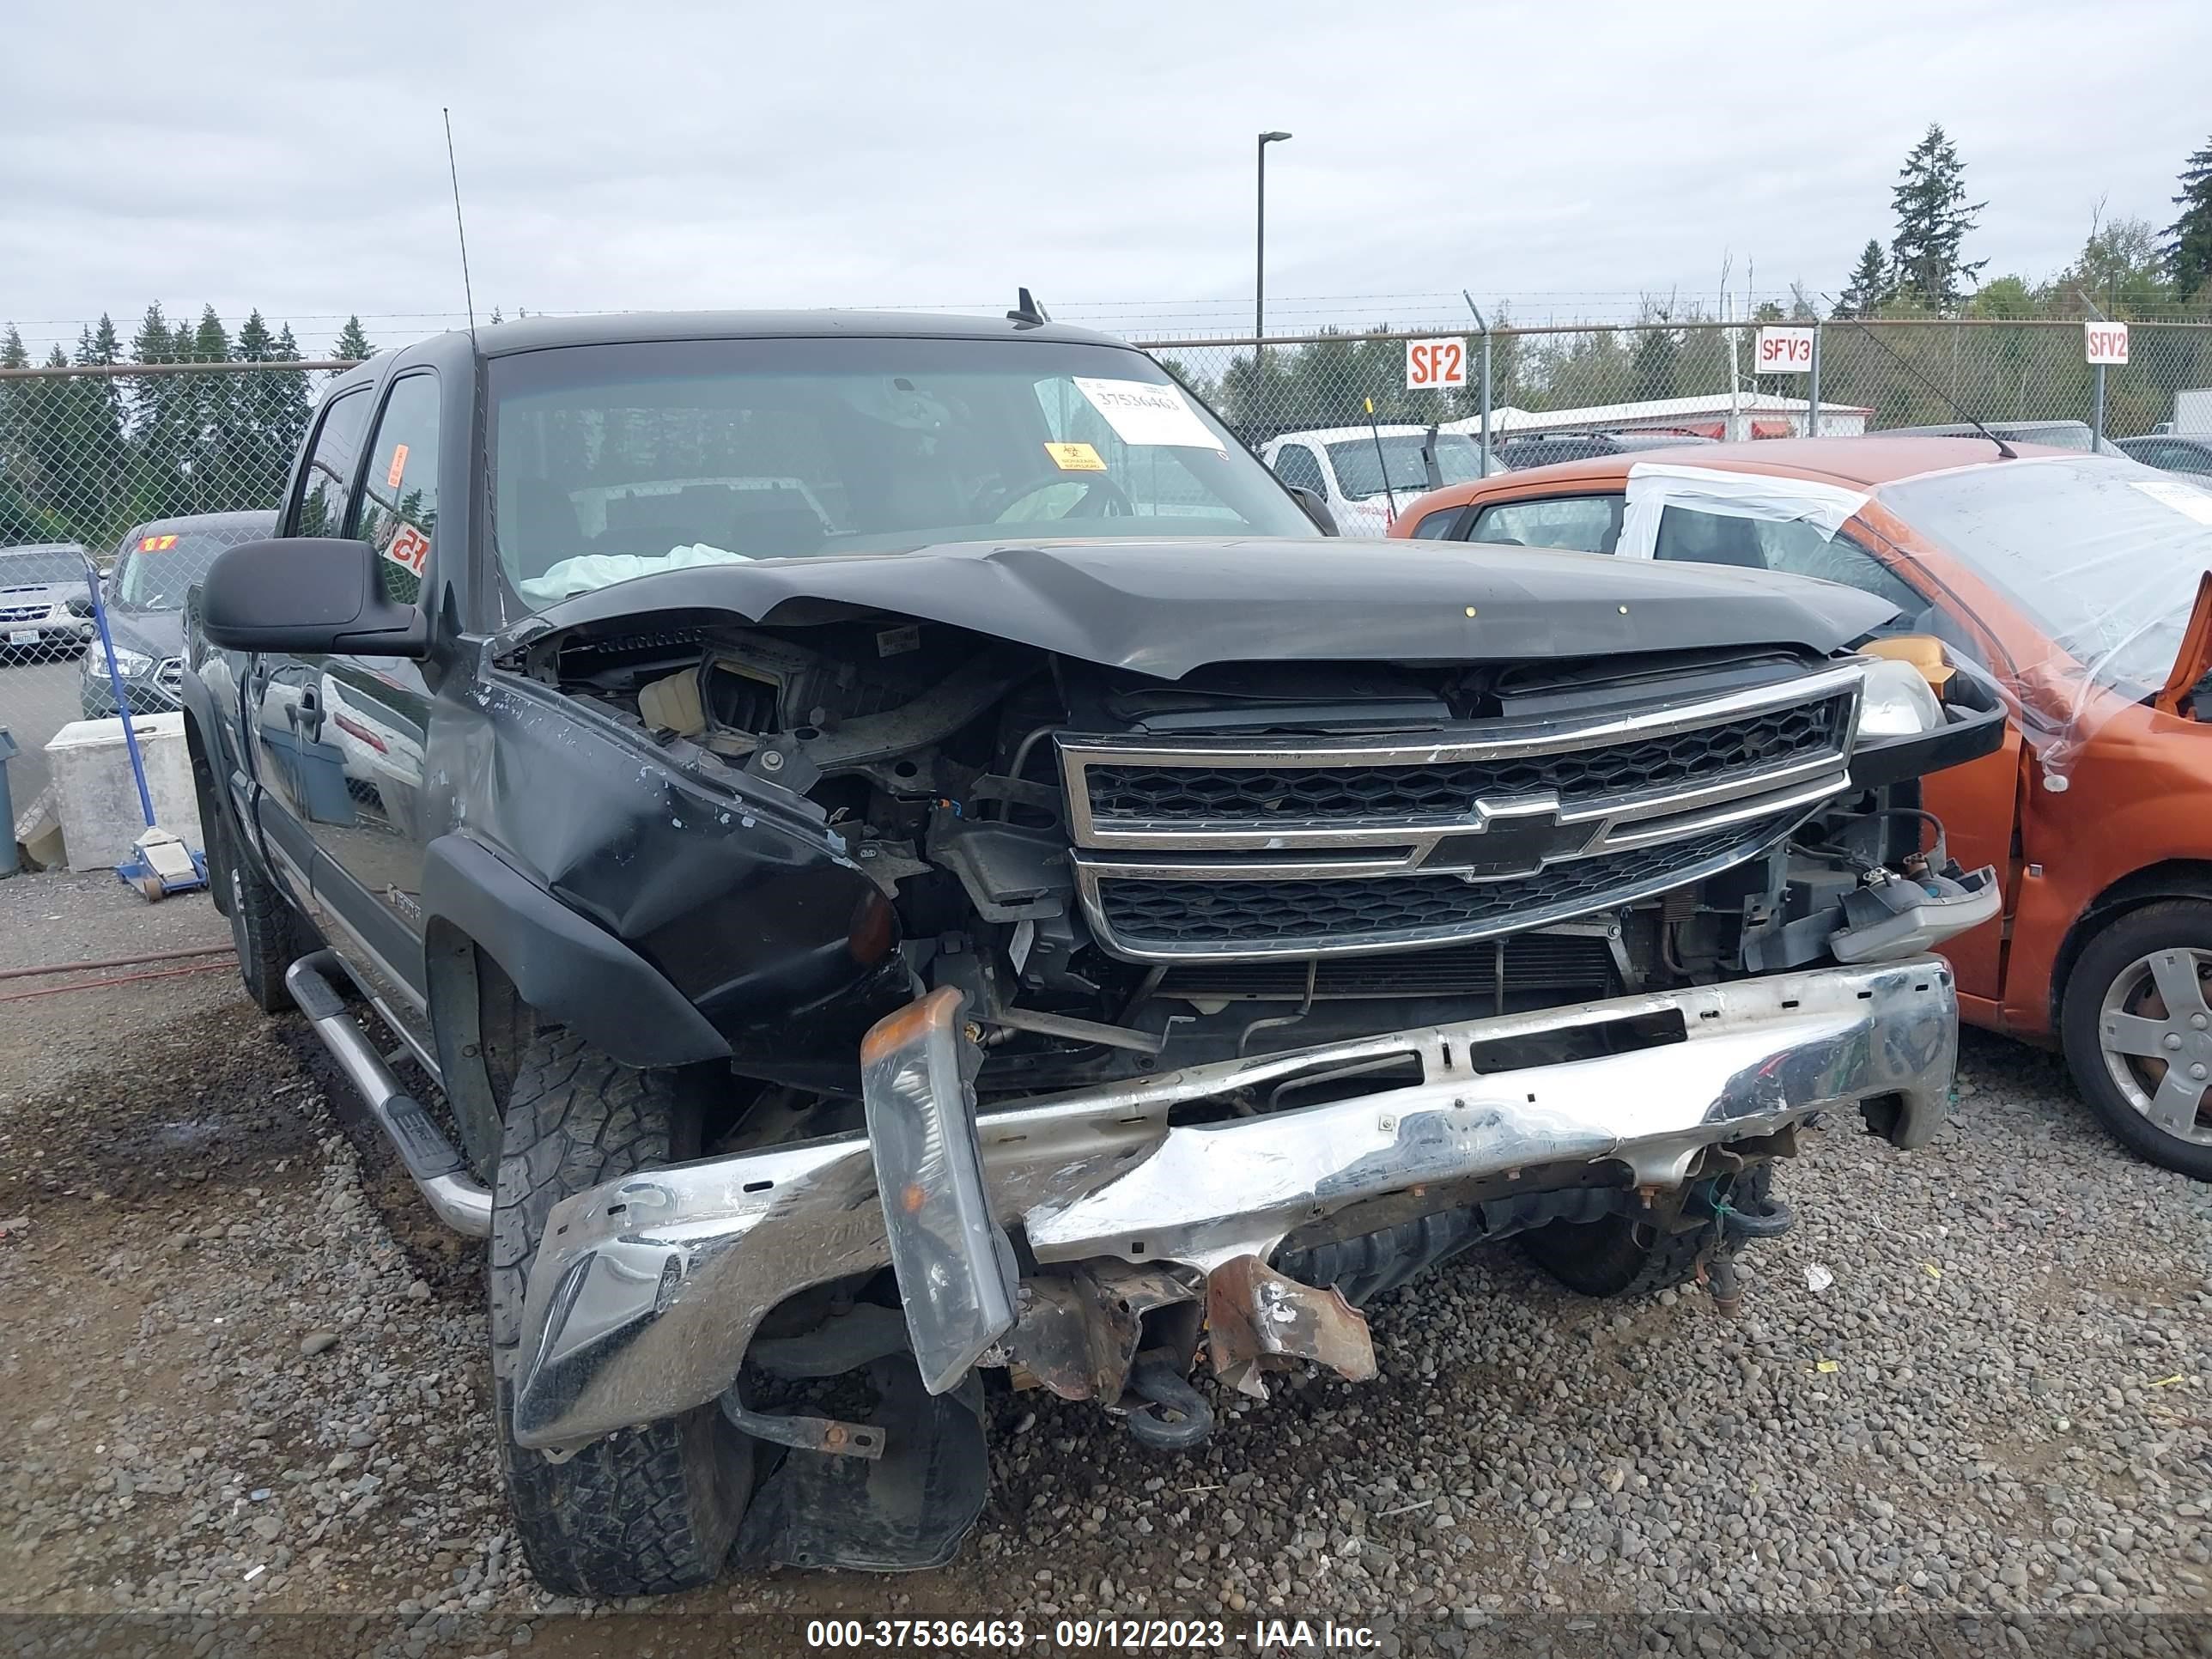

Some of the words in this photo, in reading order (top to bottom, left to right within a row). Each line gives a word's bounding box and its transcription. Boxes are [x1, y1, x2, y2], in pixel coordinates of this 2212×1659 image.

[1762, 338, 1810, 362] SFV3
[2089, 331, 2127, 356] SFV2
[1411, 343, 1461, 384] SF2
[1097, 392, 1180, 410] 37536463
[143, 535, 177, 551] 17
